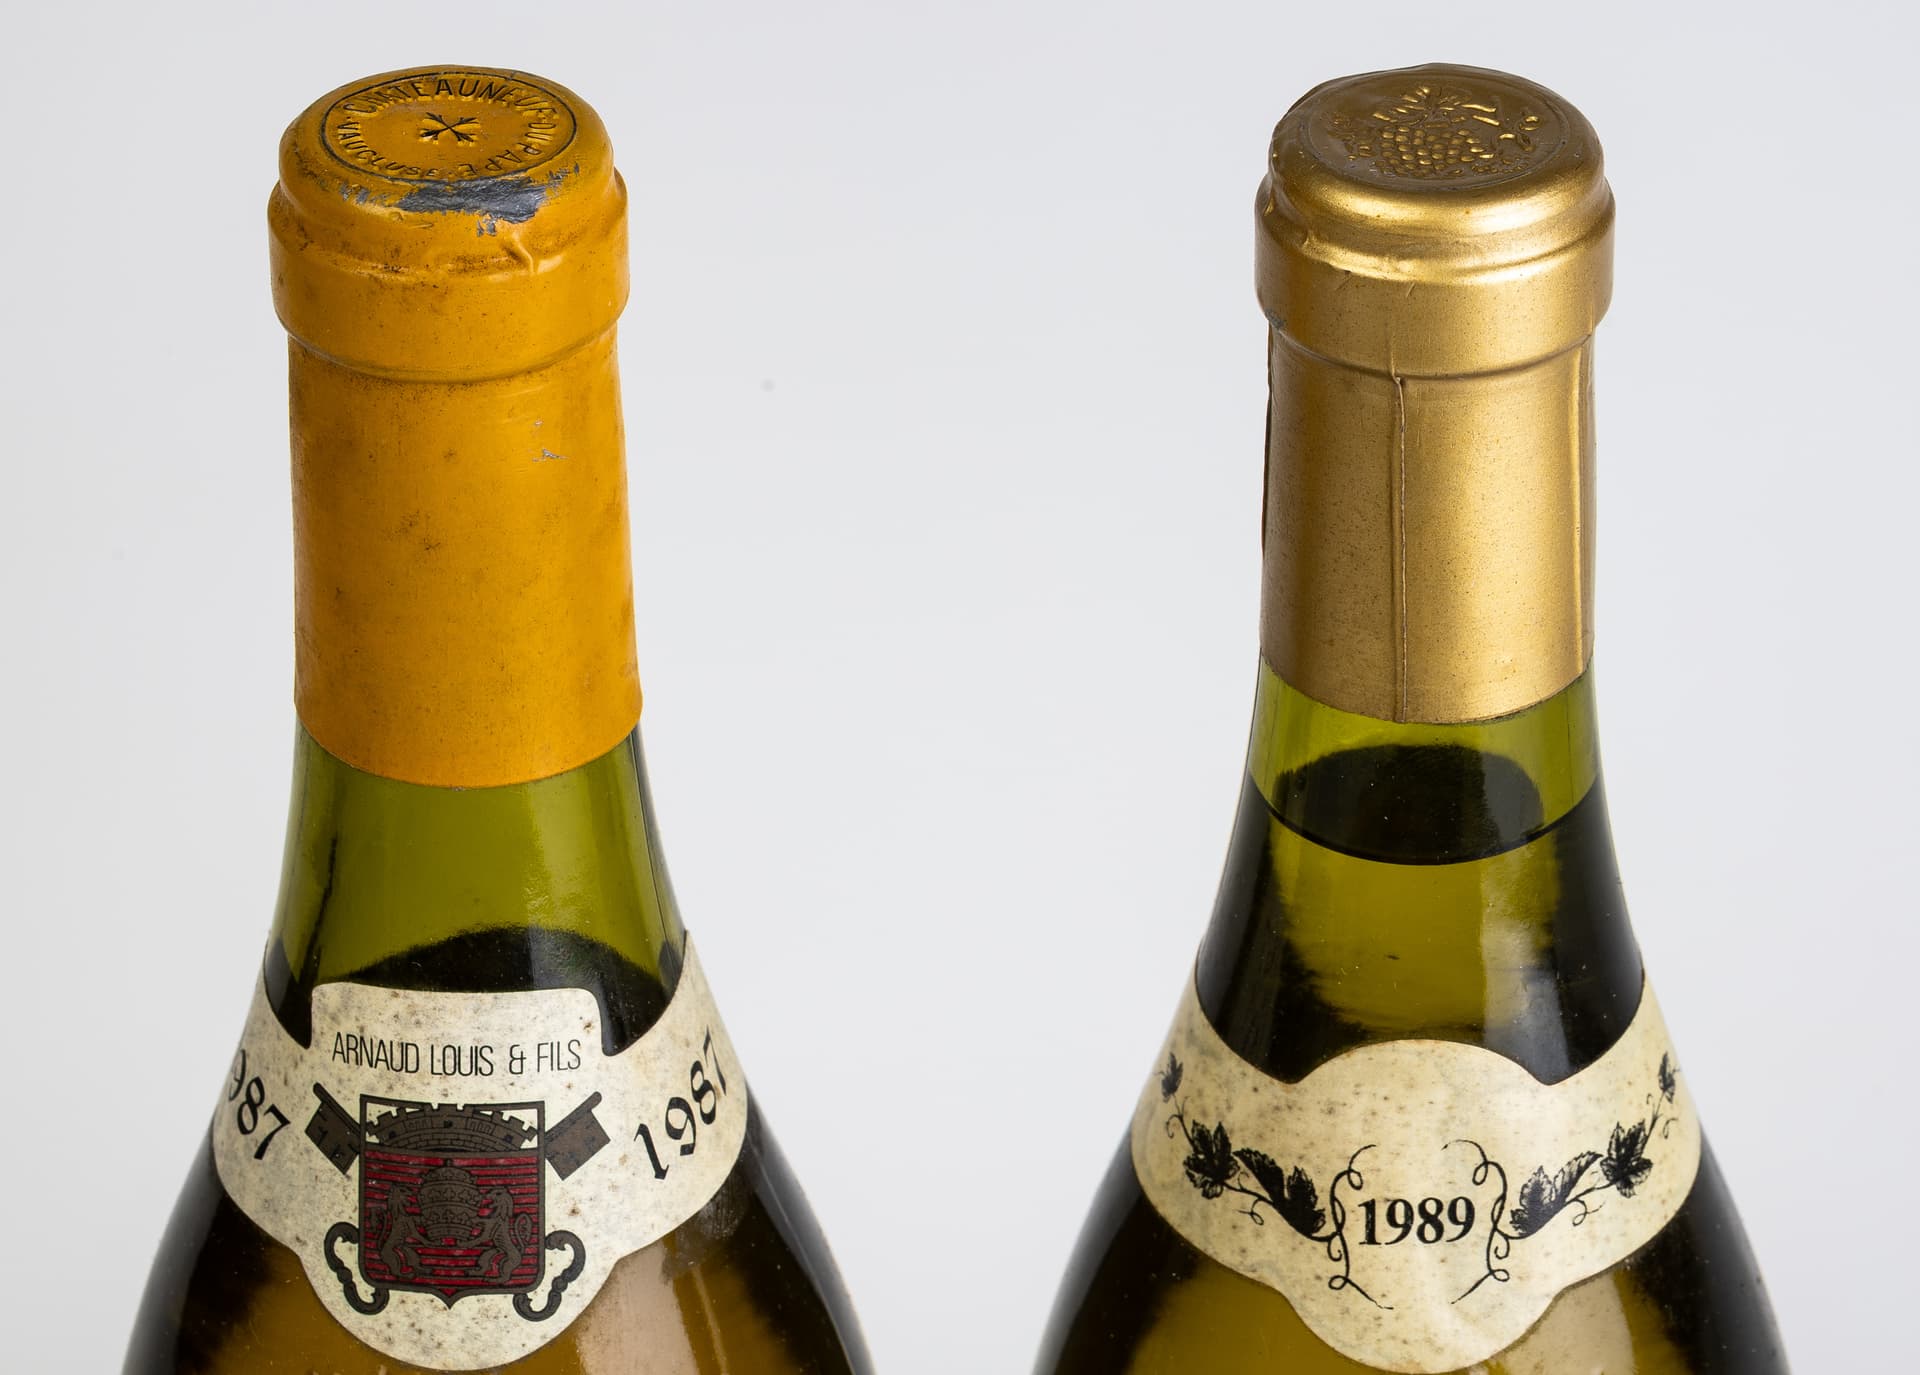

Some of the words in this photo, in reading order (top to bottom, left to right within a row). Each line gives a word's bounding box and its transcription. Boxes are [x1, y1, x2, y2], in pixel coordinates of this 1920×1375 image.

[337, 121, 438, 177] VAUCLUSE
[458, 142, 540, 173] PAPE
[332, 1031, 420, 1074] ARNAUD
[430, 1044, 494, 1077] LOUIS
[508, 1044, 527, 1075] &
[536, 1039, 582, 1073] FILS
[633, 1024, 727, 1180] 1987
[1358, 1196, 1476, 1246] 1989
